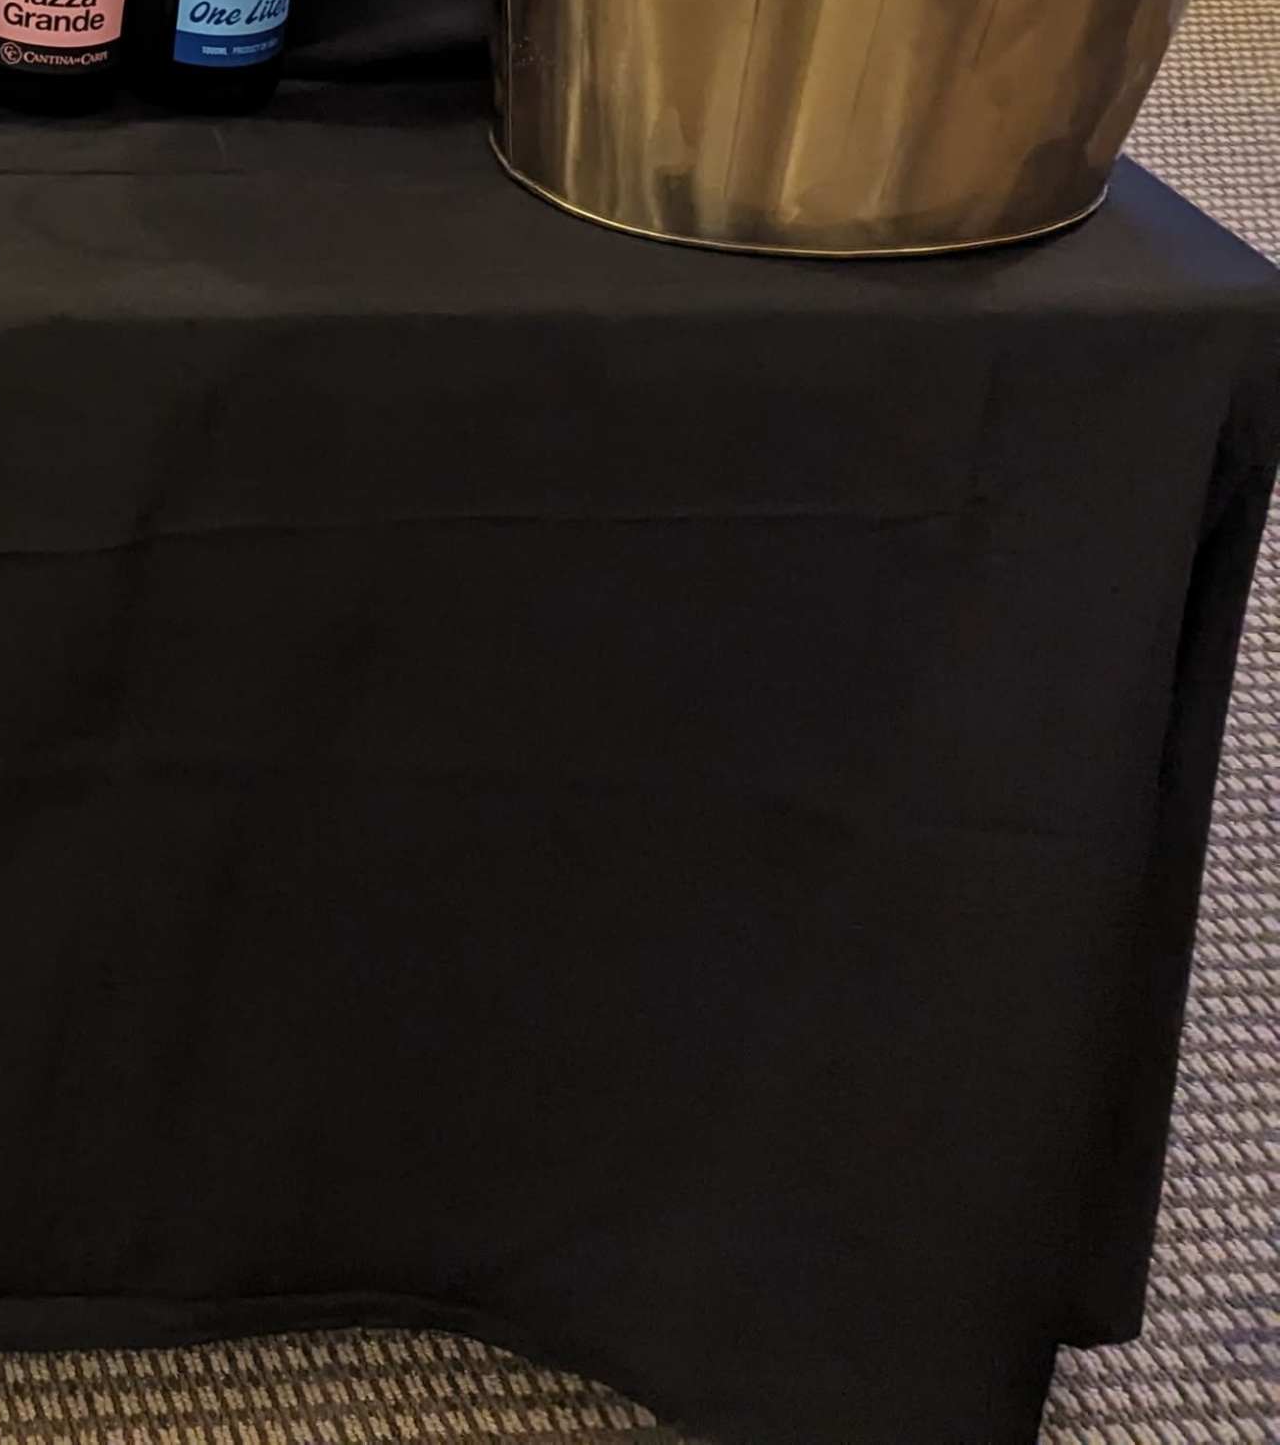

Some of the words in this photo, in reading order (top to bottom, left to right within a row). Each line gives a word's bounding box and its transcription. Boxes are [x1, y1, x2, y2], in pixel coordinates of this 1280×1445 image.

[3, 2, 105, 32] Grande
[189, 0, 242, 26] One
[23, 51, 74, 65] CANTINA
